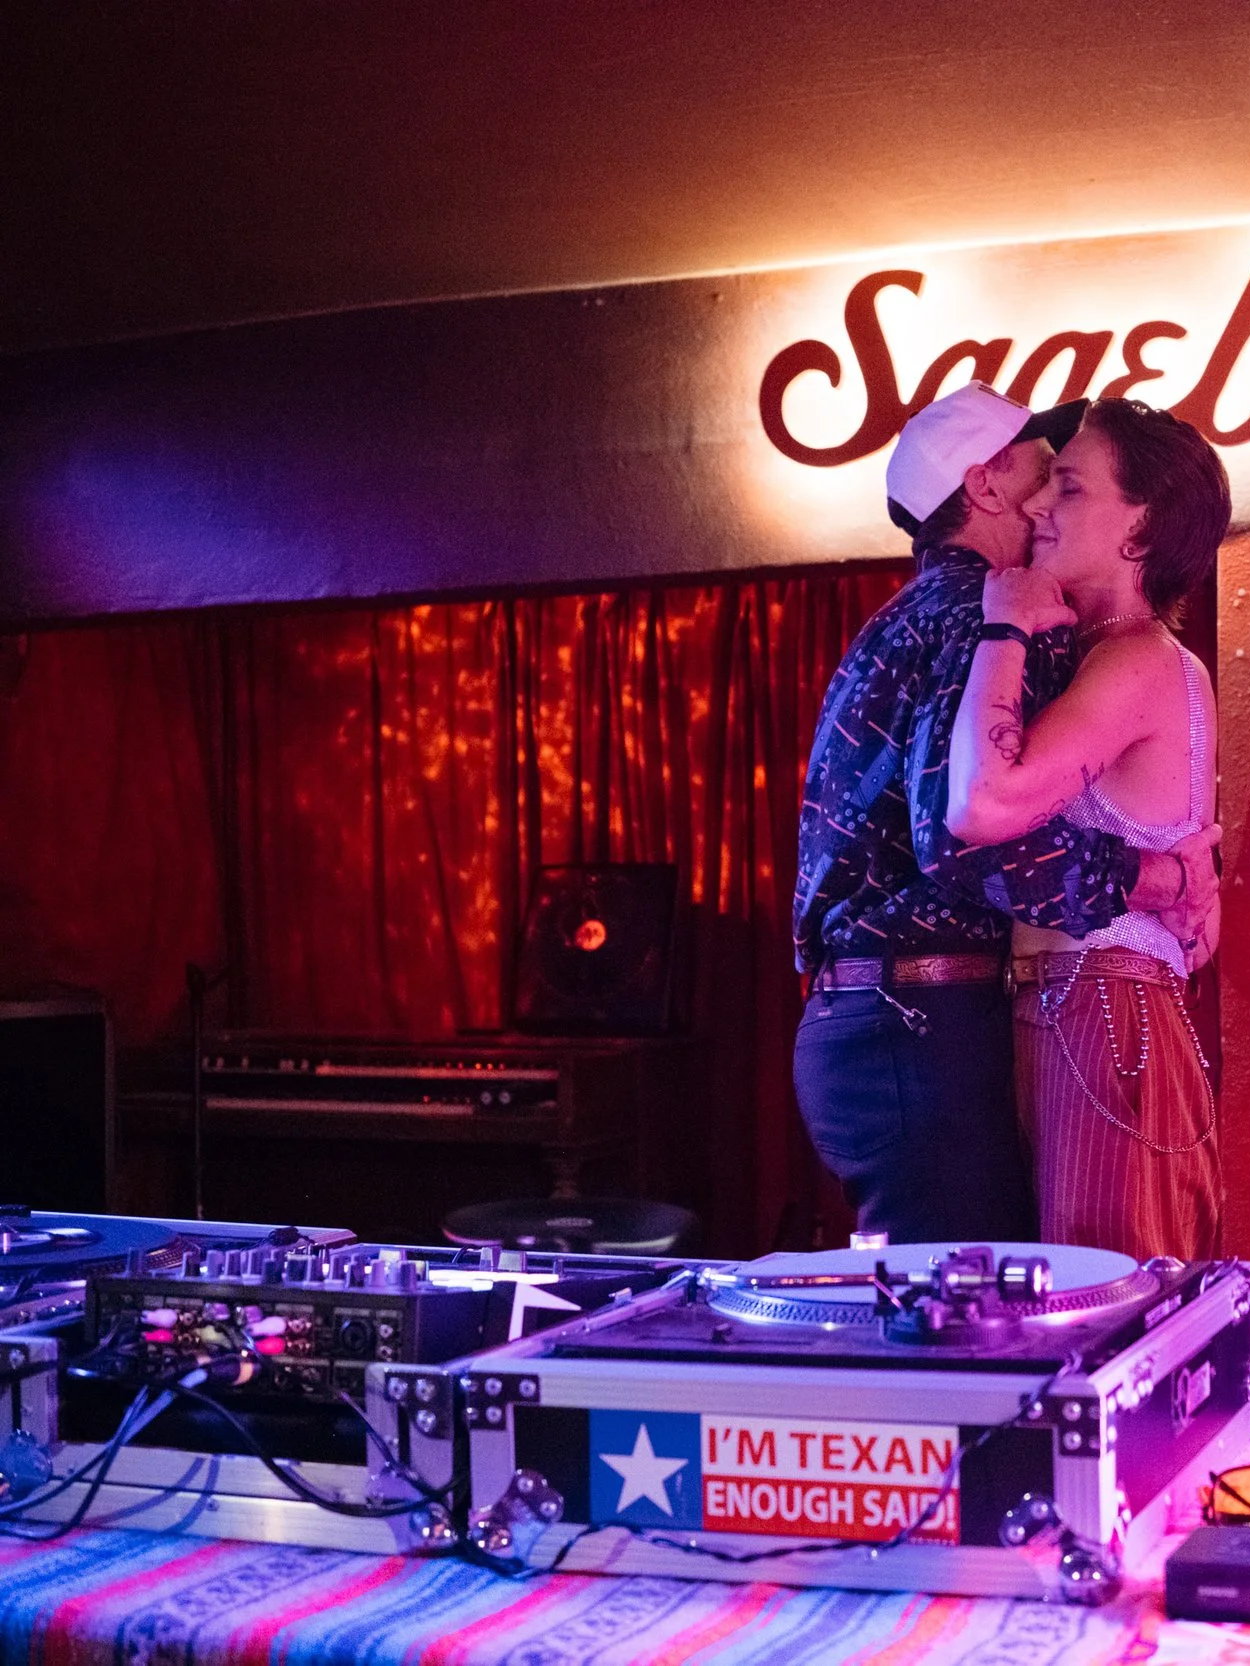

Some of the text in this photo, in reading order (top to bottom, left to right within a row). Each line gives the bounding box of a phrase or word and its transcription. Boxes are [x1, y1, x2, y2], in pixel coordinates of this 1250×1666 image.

[707, 1426, 952, 1476] I'M TEXAN
[706, 1480, 957, 1531] ENOUGH SAID!
